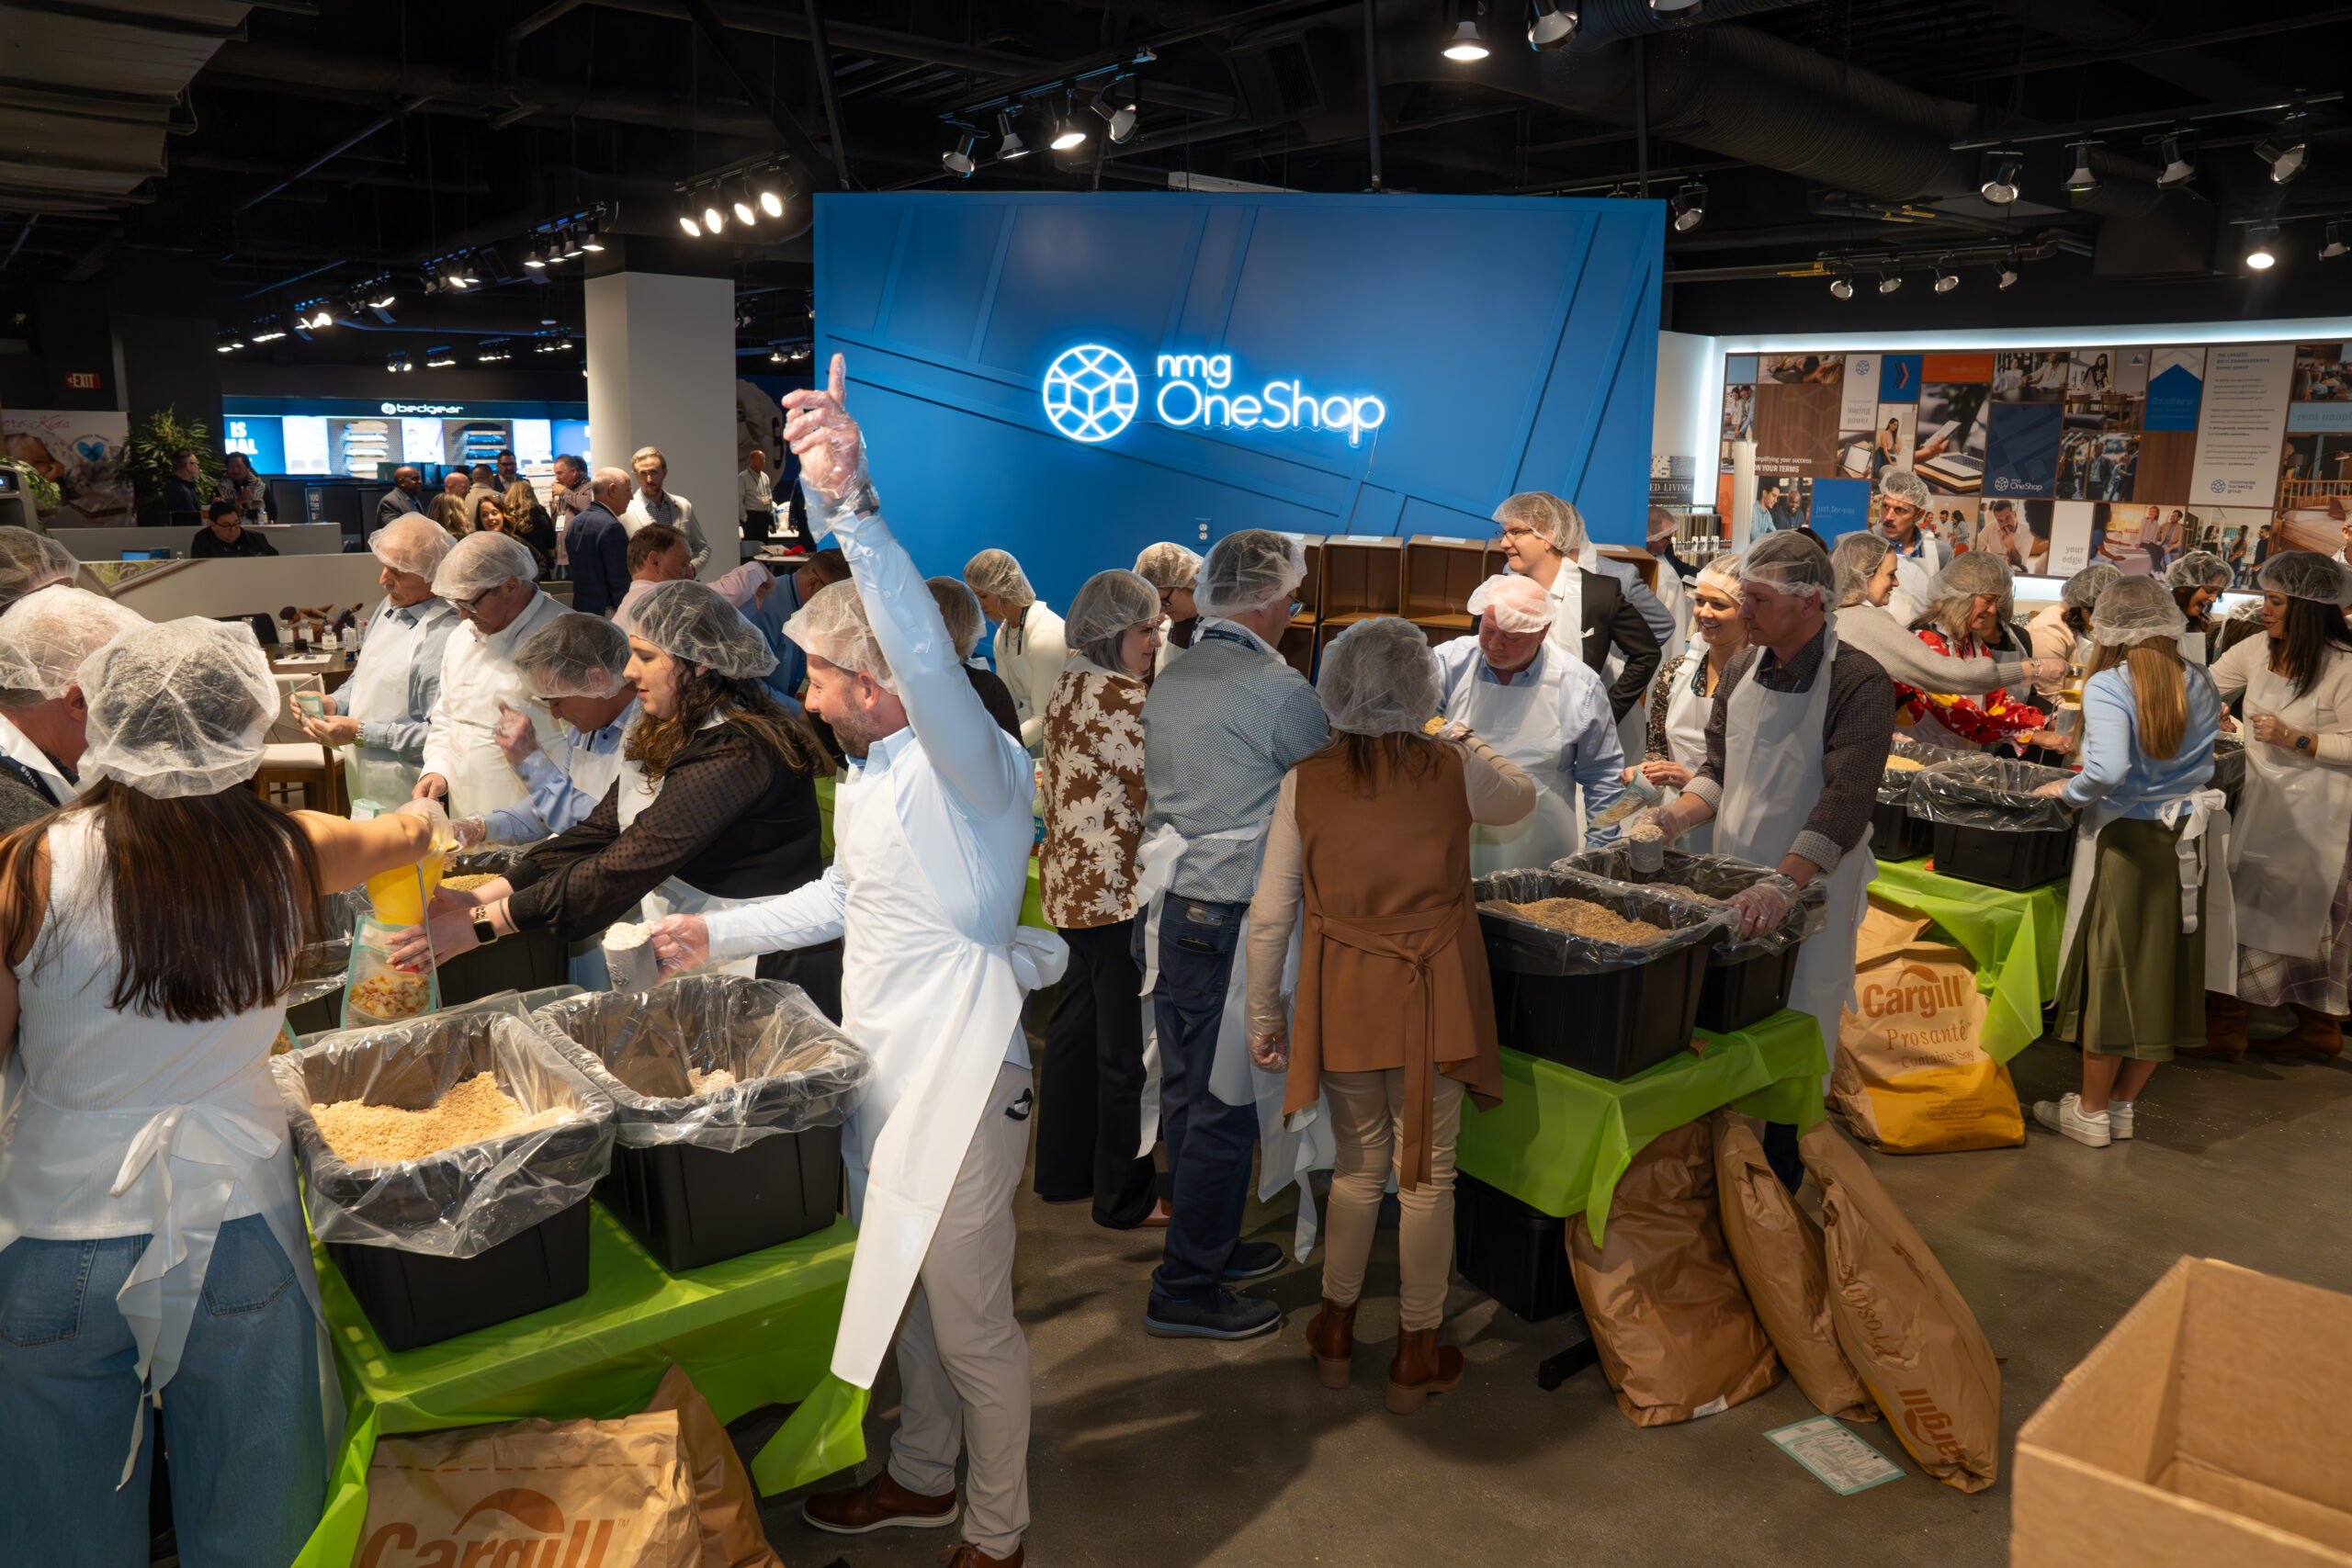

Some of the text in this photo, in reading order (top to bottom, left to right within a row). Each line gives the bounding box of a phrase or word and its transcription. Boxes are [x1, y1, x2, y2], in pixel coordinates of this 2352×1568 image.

[1157, 354, 1232, 389] nmg
[73, 373, 95, 388] EXIT
[397, 403, 462, 415] bedgear
[1157, 379, 1386, 446] OneShop
[230, 422, 247, 438] IS
[1664, 483, 1691, 492] LIVING
[2010, 482, 2043, 492] OneShop
[1862, 976, 1963, 1019] Cargill
[1885, 1019, 1968, 1051] Prosanté
[1956, 1049, 1975, 1061] Soy
[1896, 1388, 1970, 1467] argill
